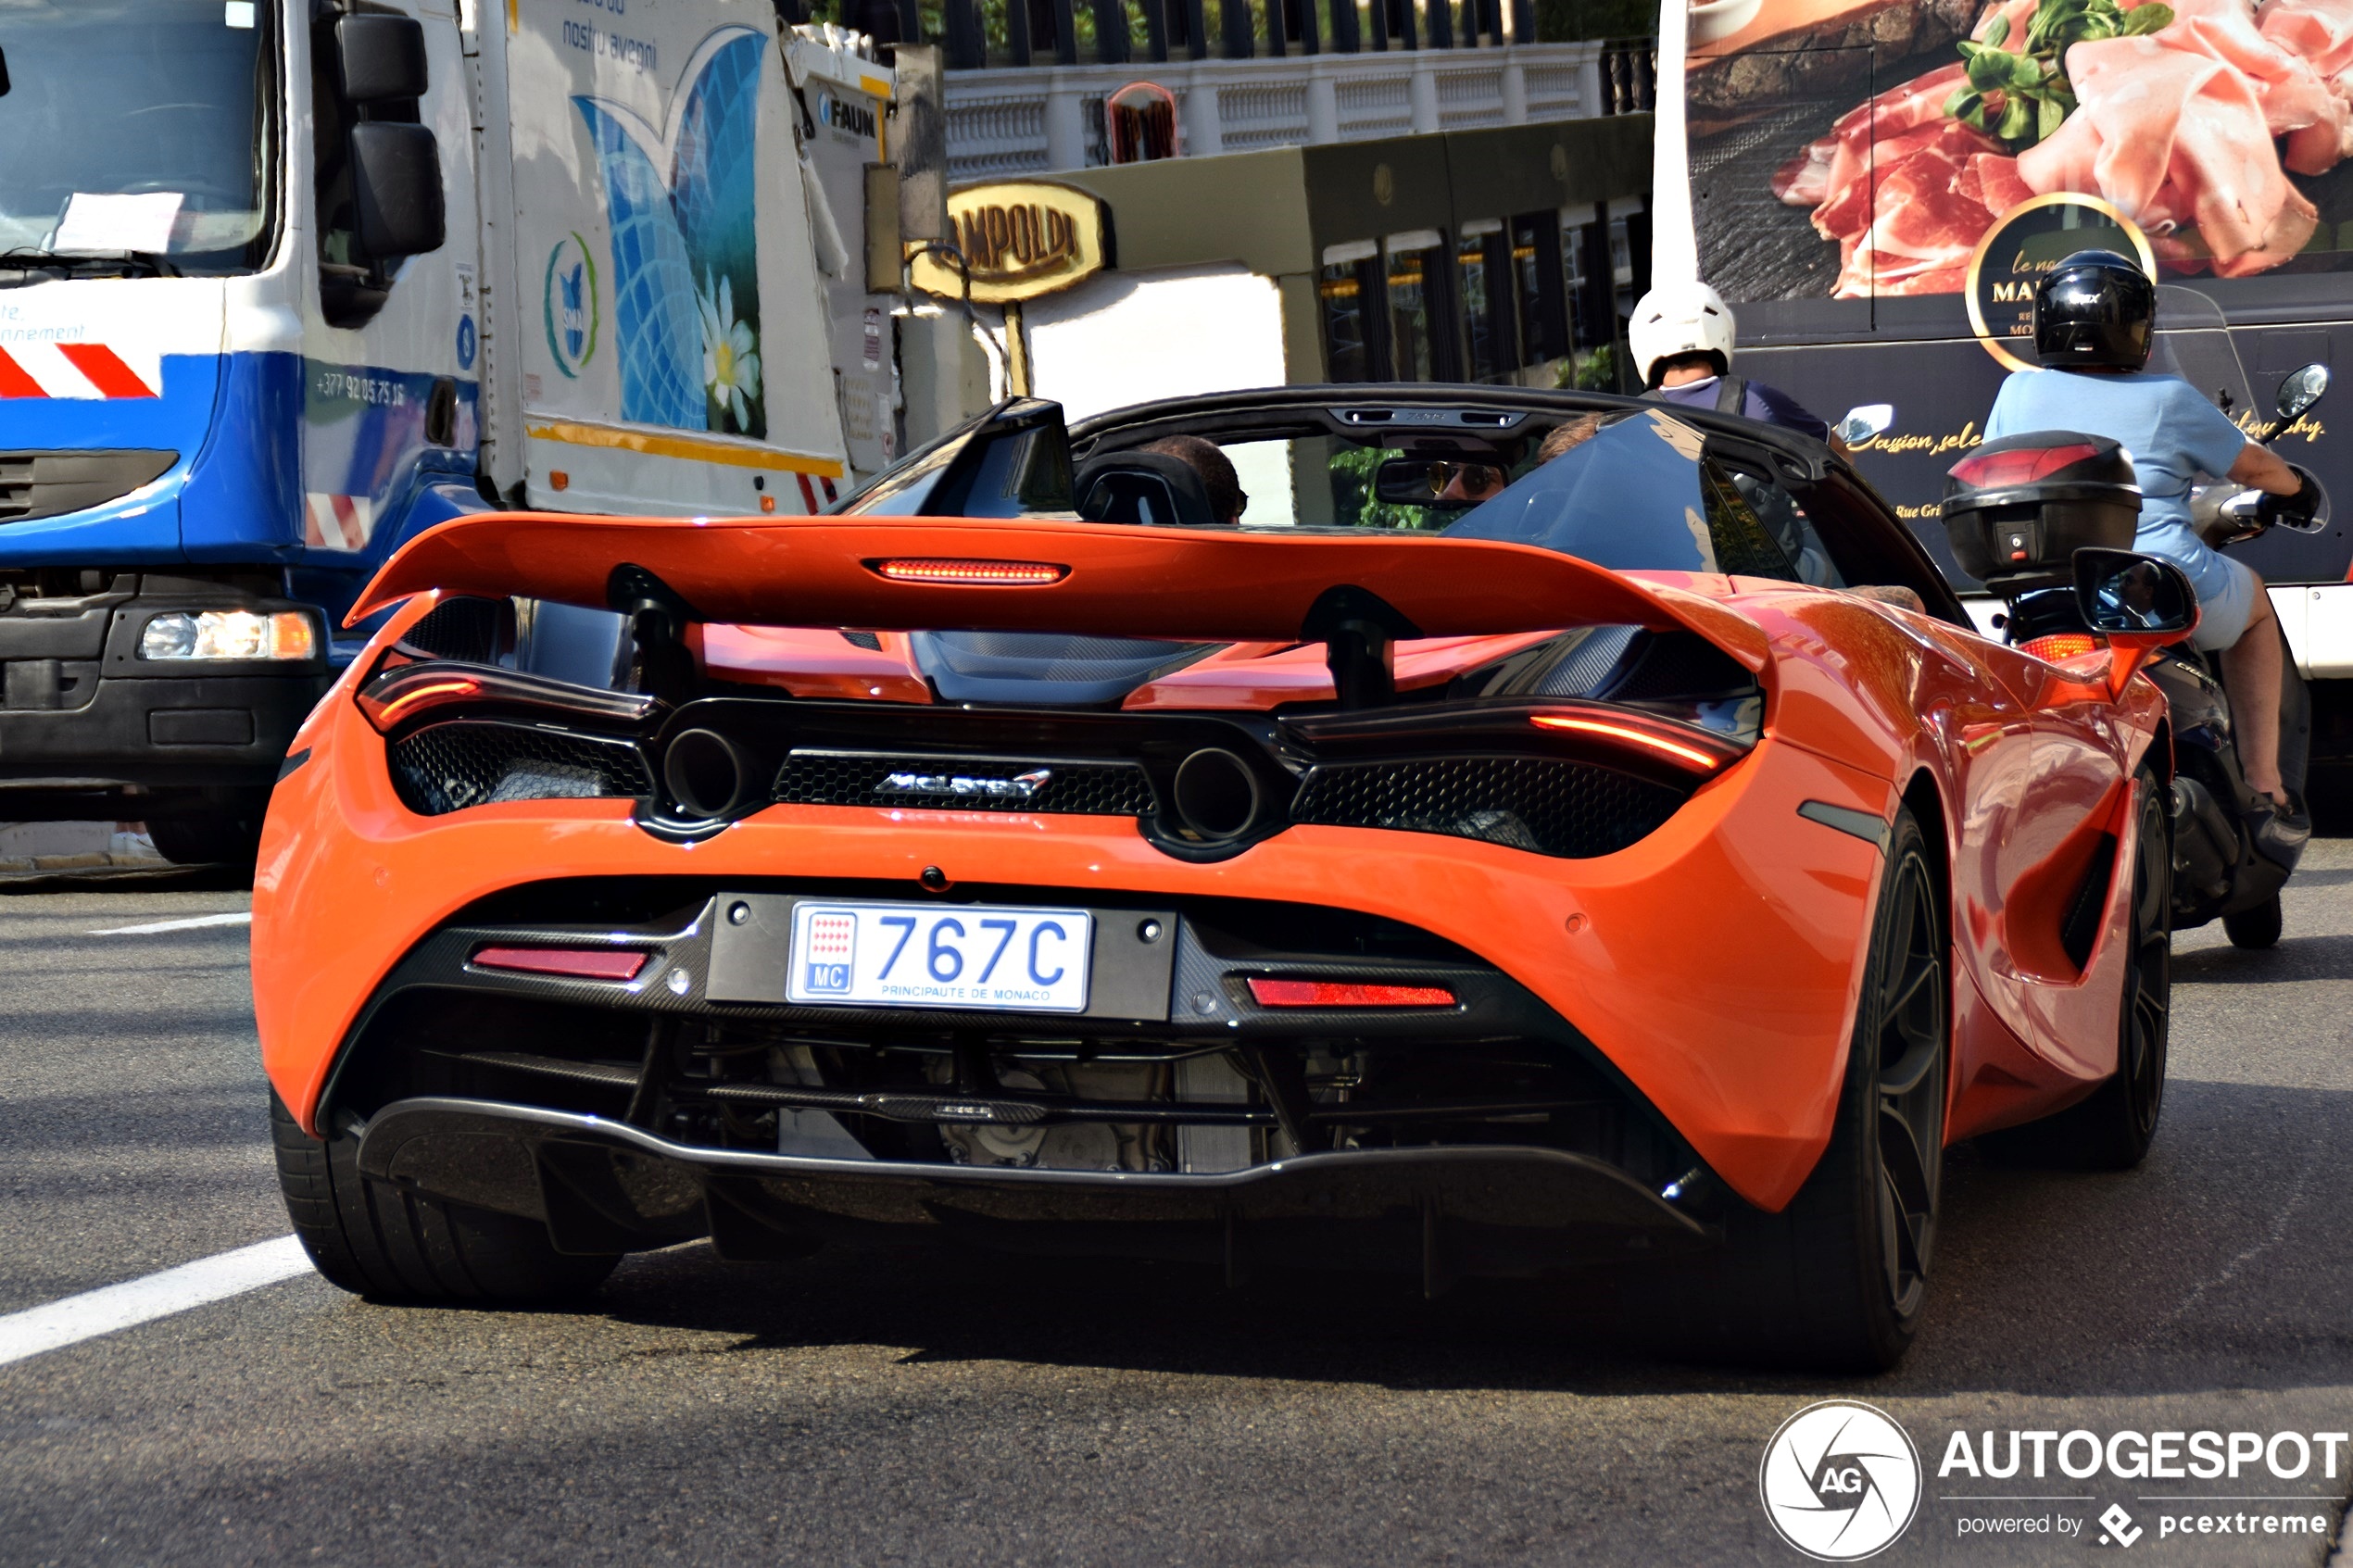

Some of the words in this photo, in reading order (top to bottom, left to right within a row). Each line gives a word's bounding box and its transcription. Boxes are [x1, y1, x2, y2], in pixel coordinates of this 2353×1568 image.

[563, 19, 605, 56] nostru
[610, 38, 657, 75] avegni
[831, 99, 875, 139] FAUN
[2011, 249, 2032, 274] le
[1992, 281, 2041, 303] MA
[317, 372, 342, 396] +377
[346, 375, 359, 400] 92
[877, 916, 1066, 986] 767C
[813, 965, 842, 988] MC
[881, 985, 965, 998] PRINCIPAUTE
[972, 987, 988, 999] DE
[993, 989, 1051, 1001] MONACO
